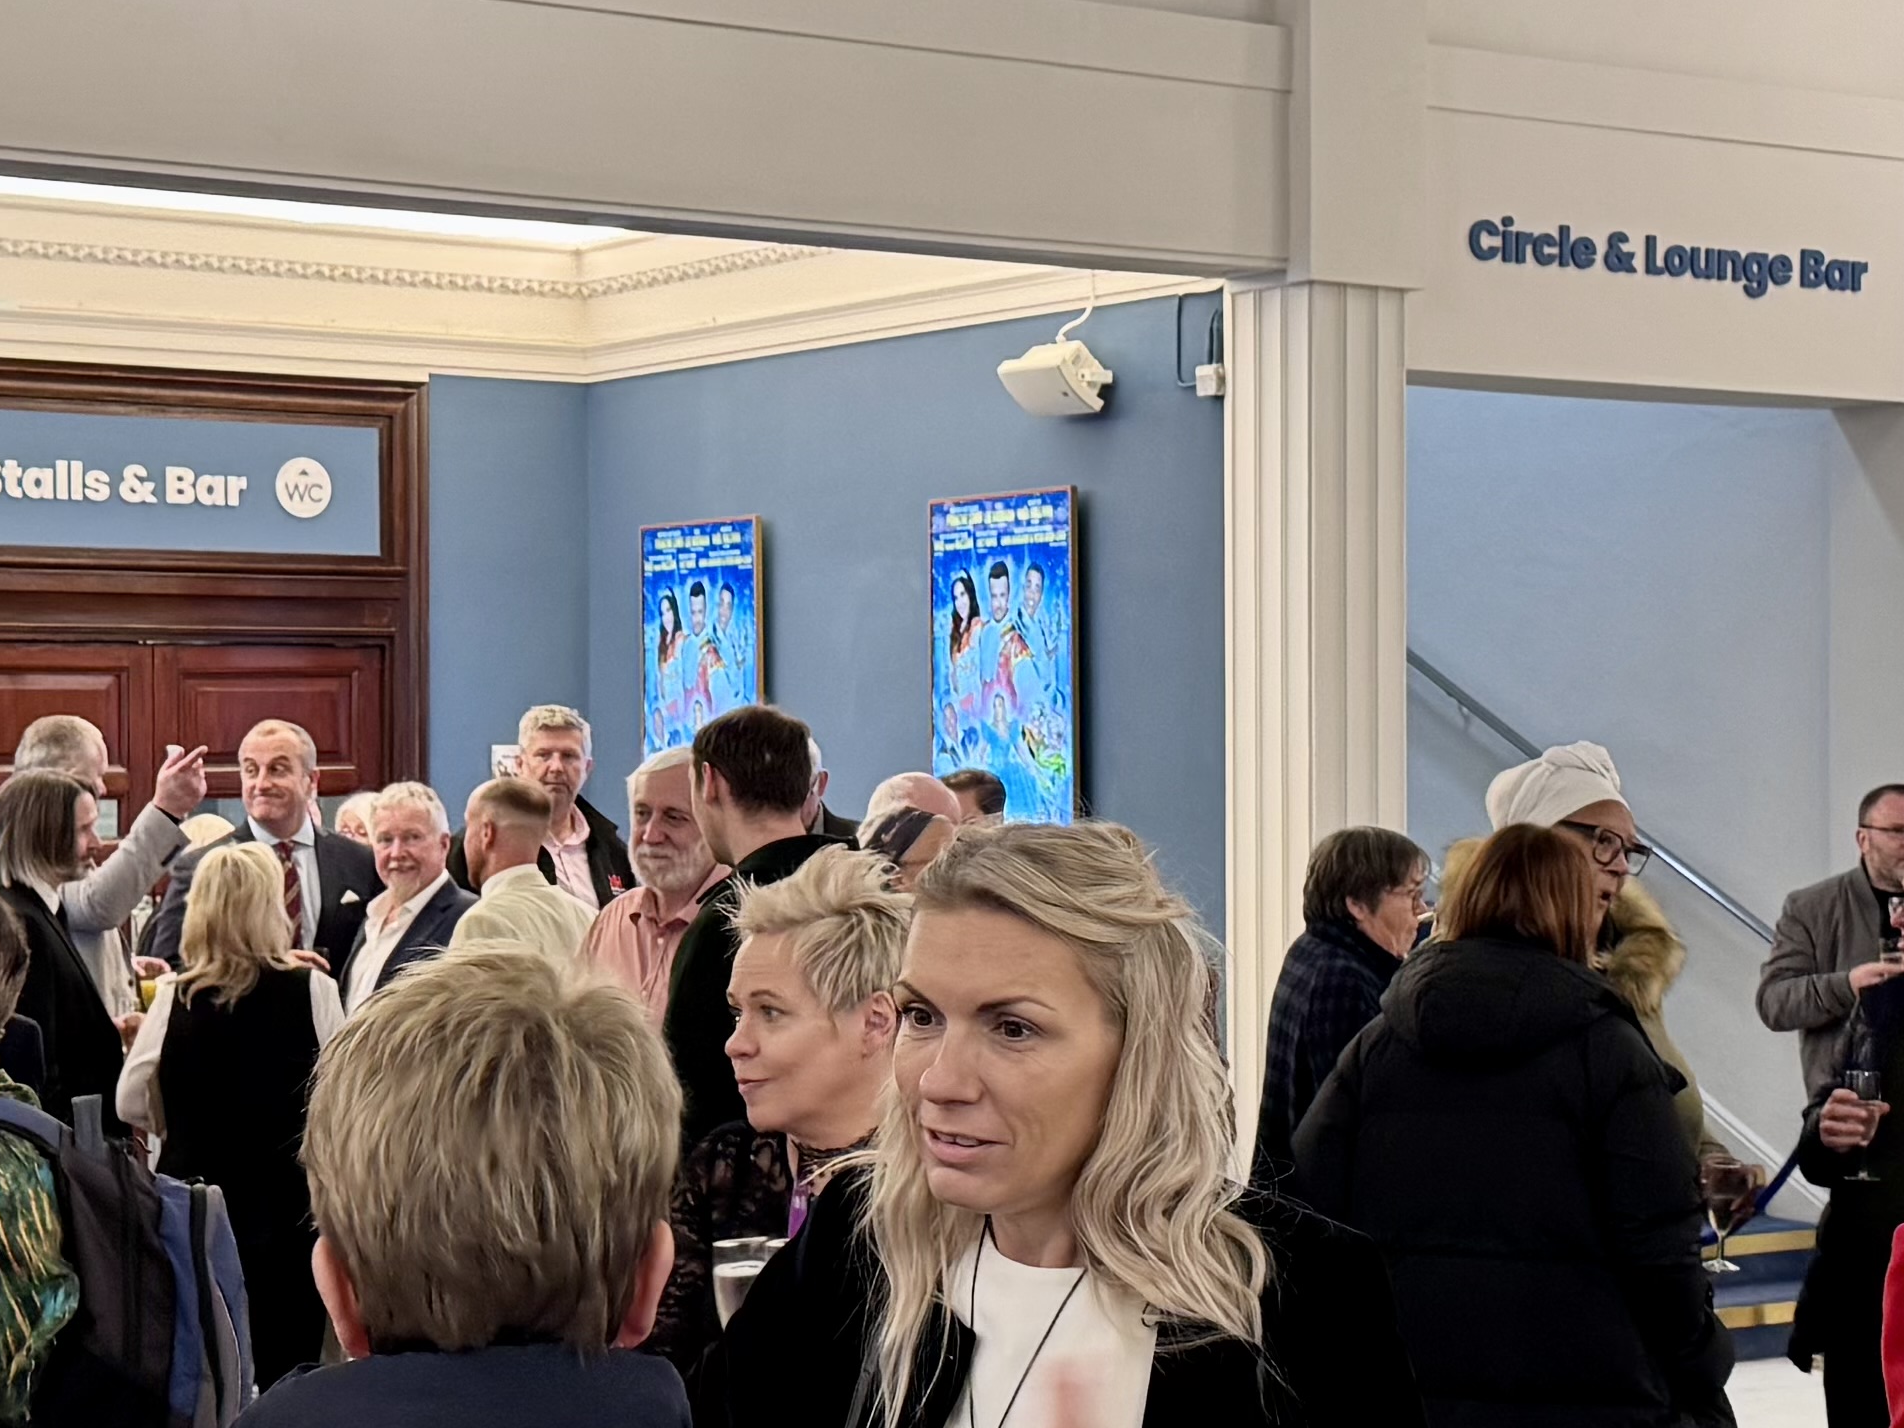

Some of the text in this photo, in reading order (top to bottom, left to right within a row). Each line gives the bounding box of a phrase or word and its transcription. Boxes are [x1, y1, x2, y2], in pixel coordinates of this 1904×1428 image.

[1468, 215, 1869, 299] Circle & Lounge Bar
[118, 463, 159, 504] &
[164, 465, 248, 508] Bar
[284, 481, 324, 503] WC
